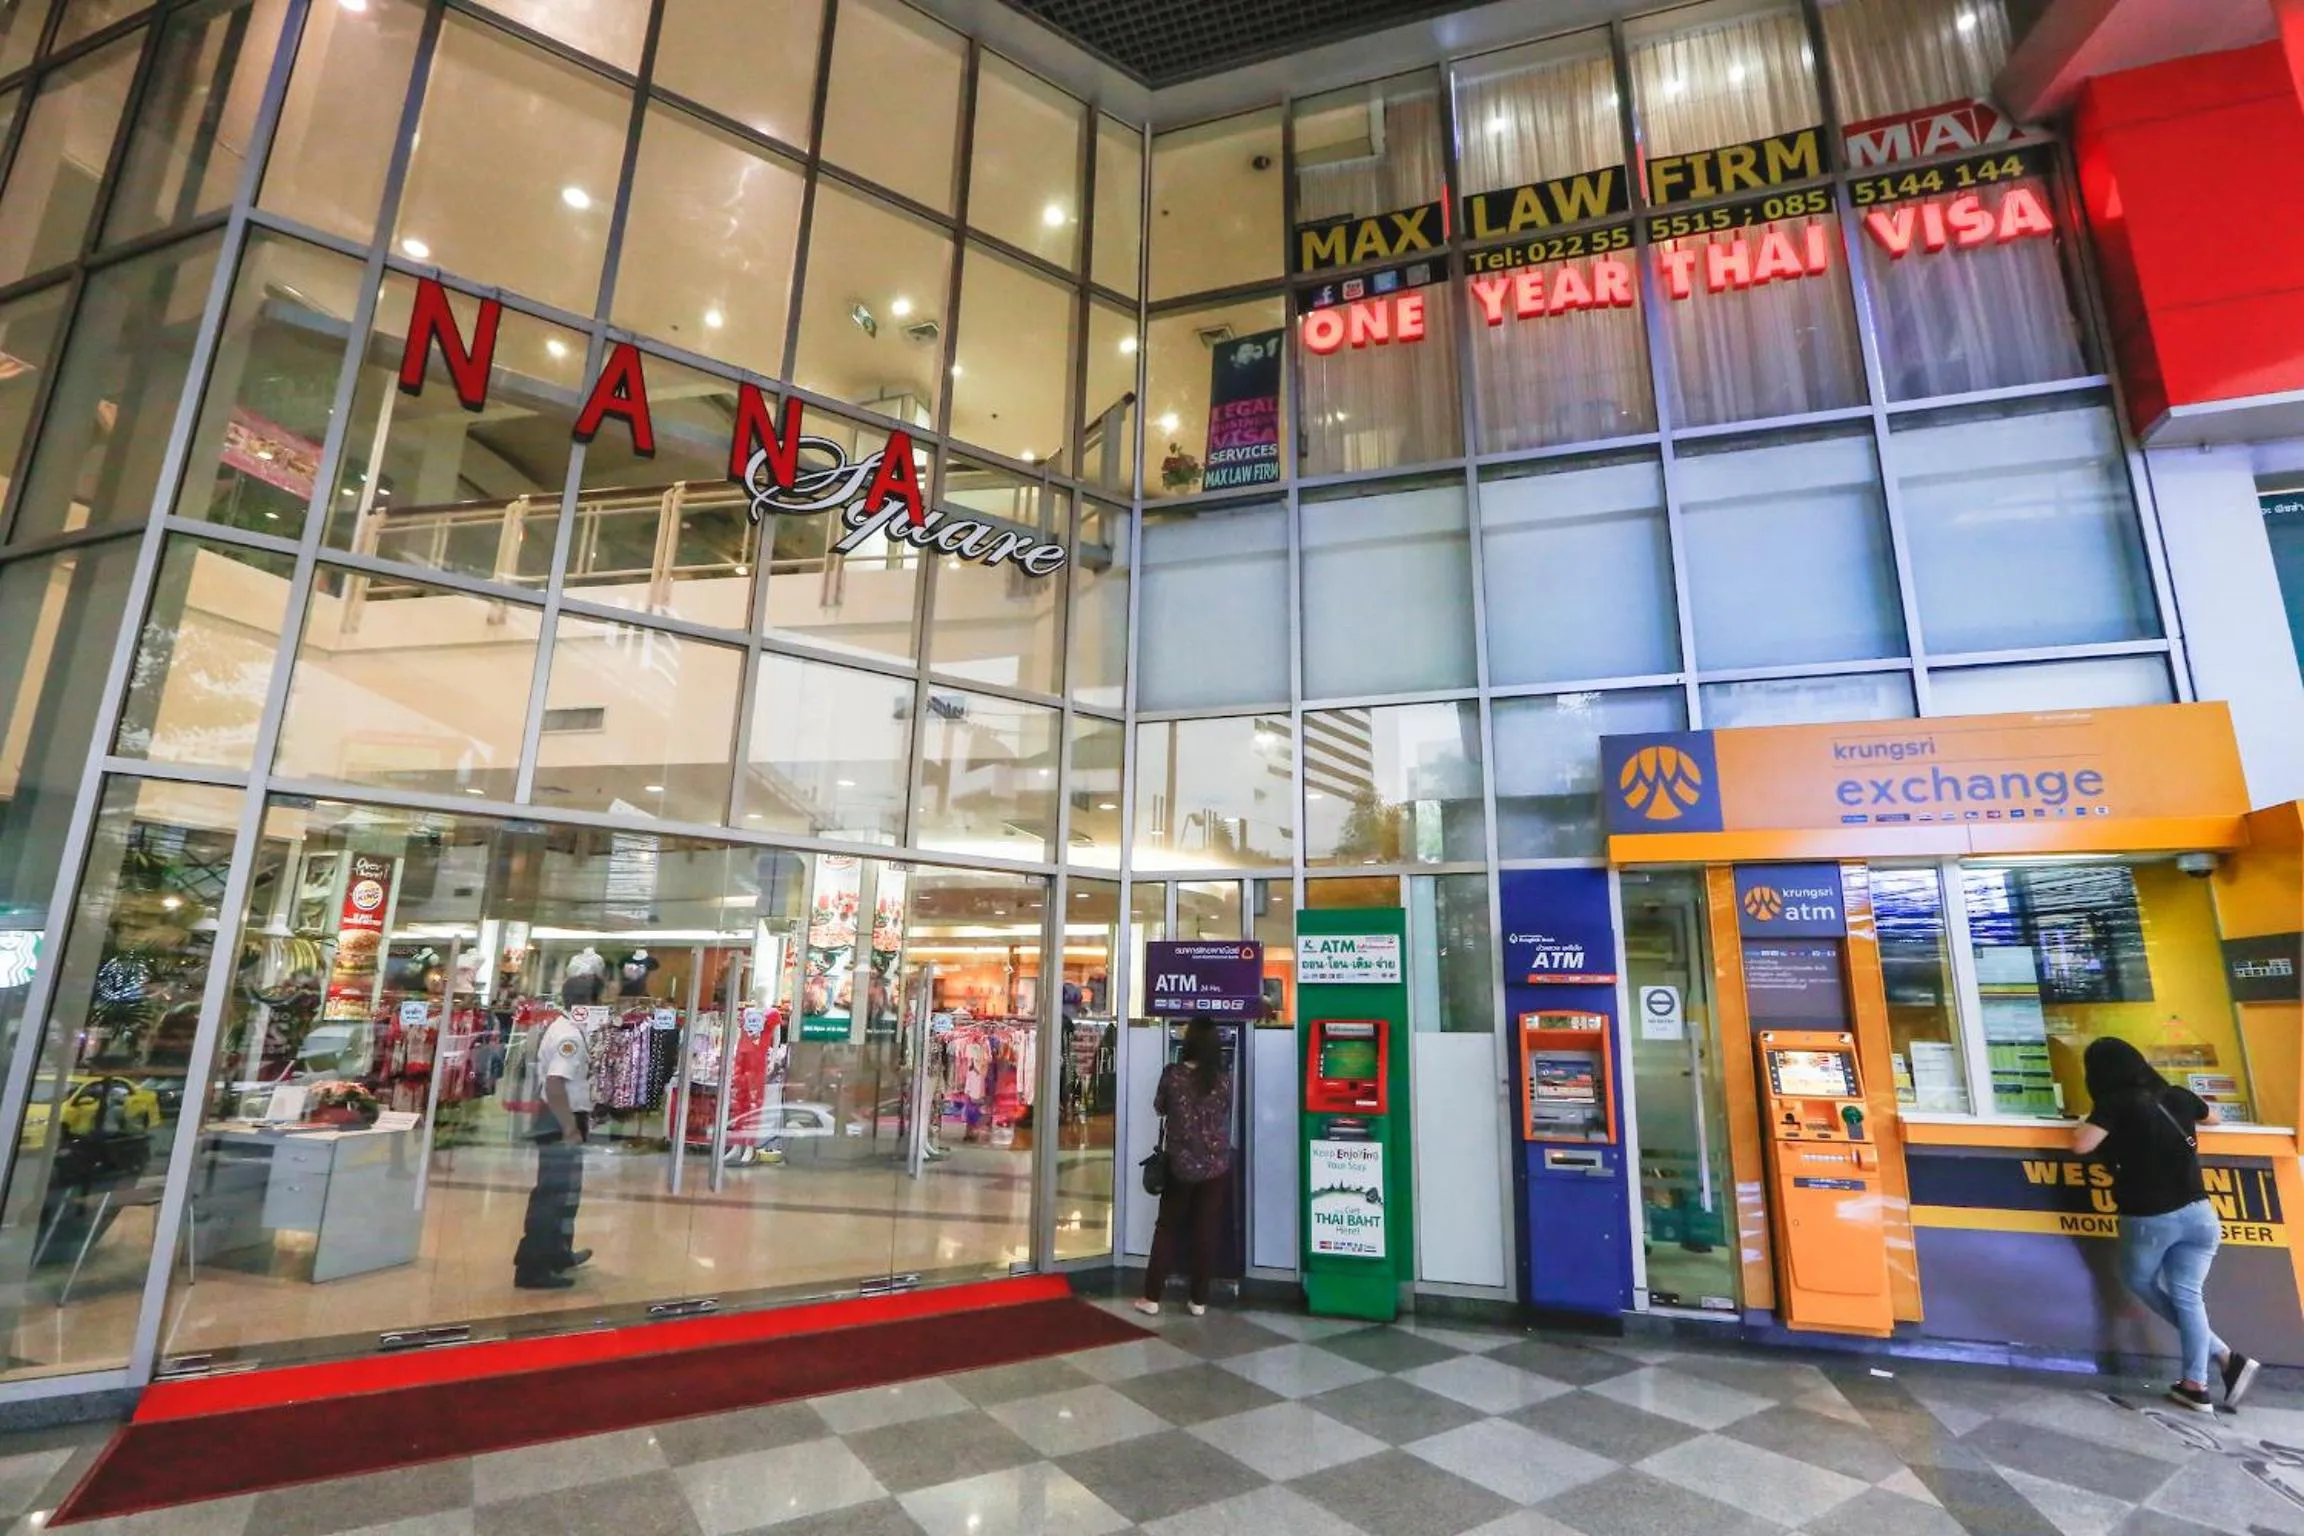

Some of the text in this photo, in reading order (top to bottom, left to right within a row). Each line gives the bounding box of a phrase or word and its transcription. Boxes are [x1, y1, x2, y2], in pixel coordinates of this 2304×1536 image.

[1302, 129, 1820, 272] MAX LAW FIRM
[1593, 226, 1630, 252] 55
[1651, 208, 1732, 242] 5515
[1764, 191, 1828, 222] 085
[1854, 168, 1943, 203] 5144
[1956, 154, 2024, 188] 144
[1303, 188, 2053, 355] ONE YEAR THAI VISA
[1209, 444, 1278, 464] SERVICES
[1205, 462, 1279, 488] MAX LAW FIRM
[743, 434, 1068, 579] Square
[1833, 737, 1936, 761] krungsri
[1836, 766, 2104, 806] exchange
[1782, 886, 1834, 900] krungsri
[1784, 902, 1836, 921] atm
[1320, 939, 1356, 953] ATM
[1532, 952, 1585, 969] ATM
[1155, 974, 1197, 992] ATM
[1315, 1212, 1382, 1229] THAI BAHT
[2060, 1216, 2119, 1234] MON
